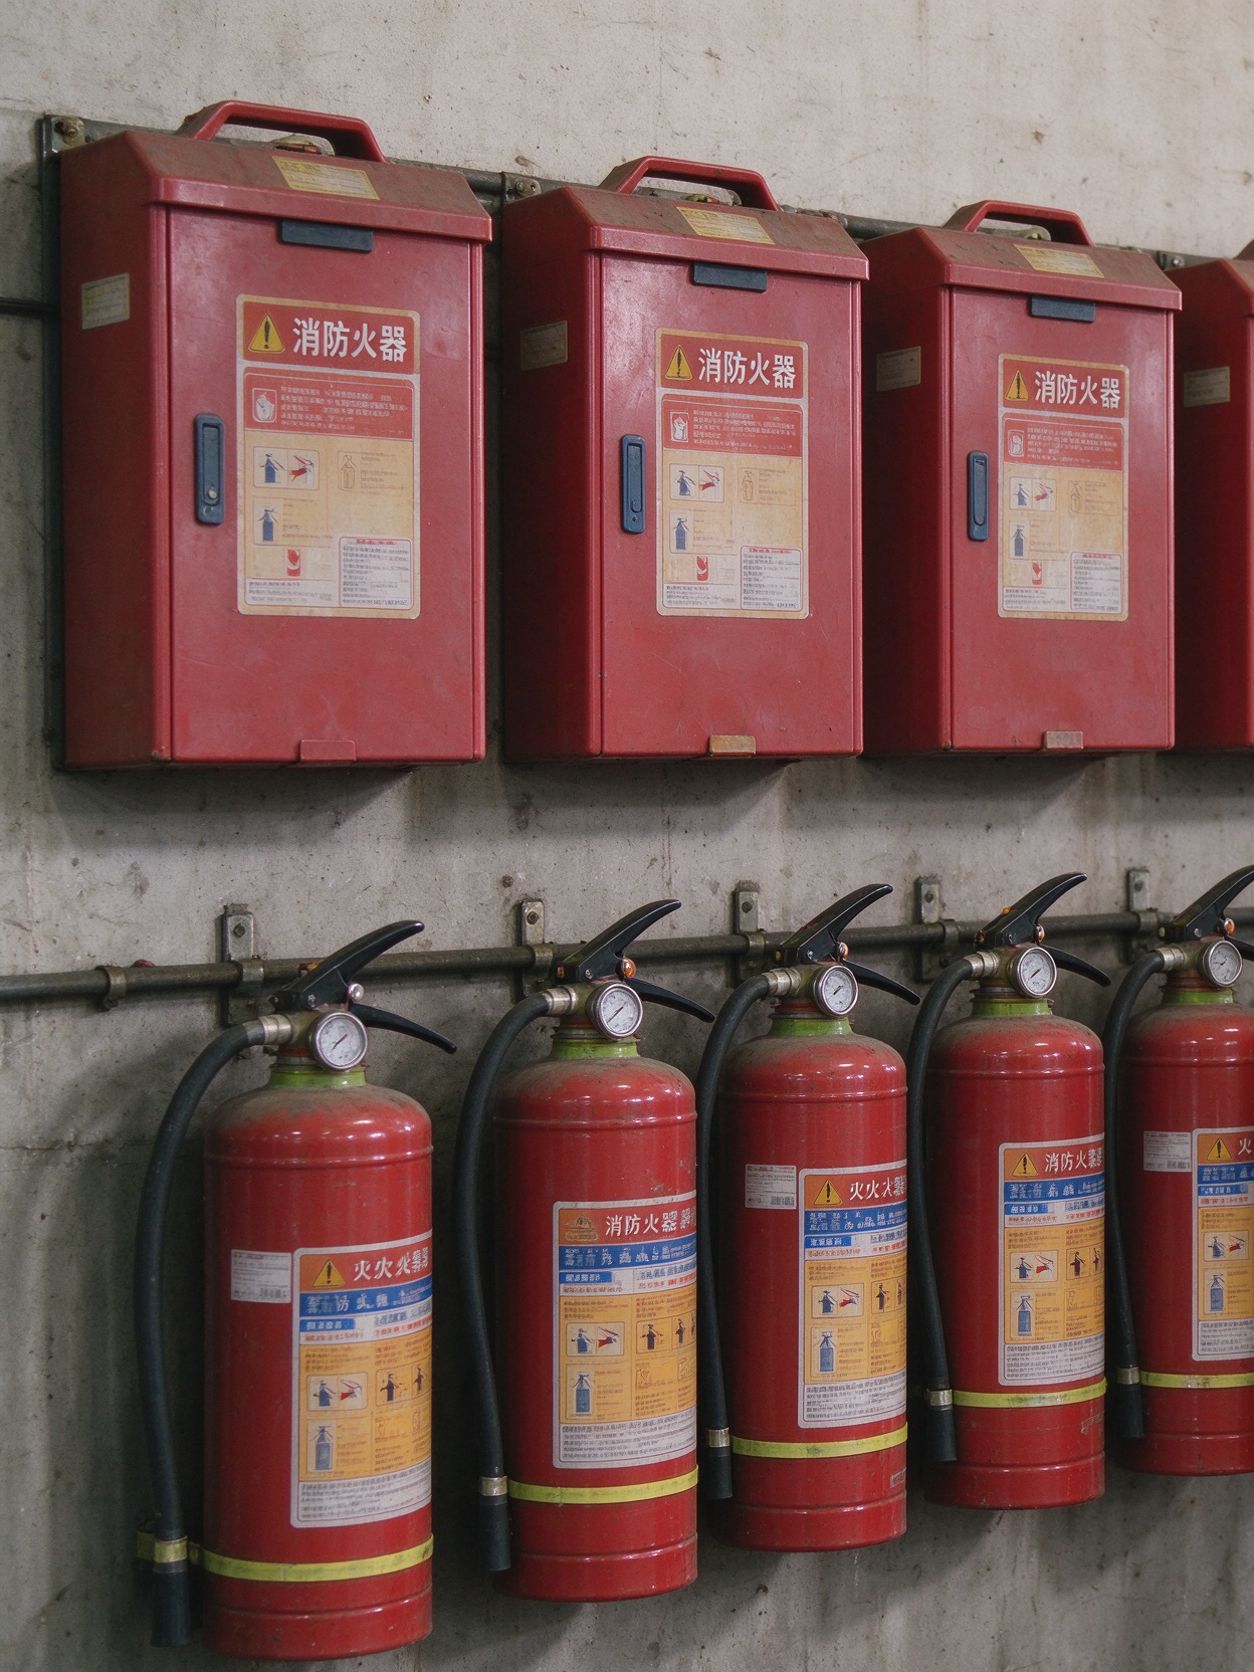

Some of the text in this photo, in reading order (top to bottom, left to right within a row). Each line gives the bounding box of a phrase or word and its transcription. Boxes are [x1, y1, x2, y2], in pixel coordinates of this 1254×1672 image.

[292, 317, 408, 362] 消防火器
[698, 347, 796, 388] 消防火器
[1034, 370, 1121, 409] 消防火器
